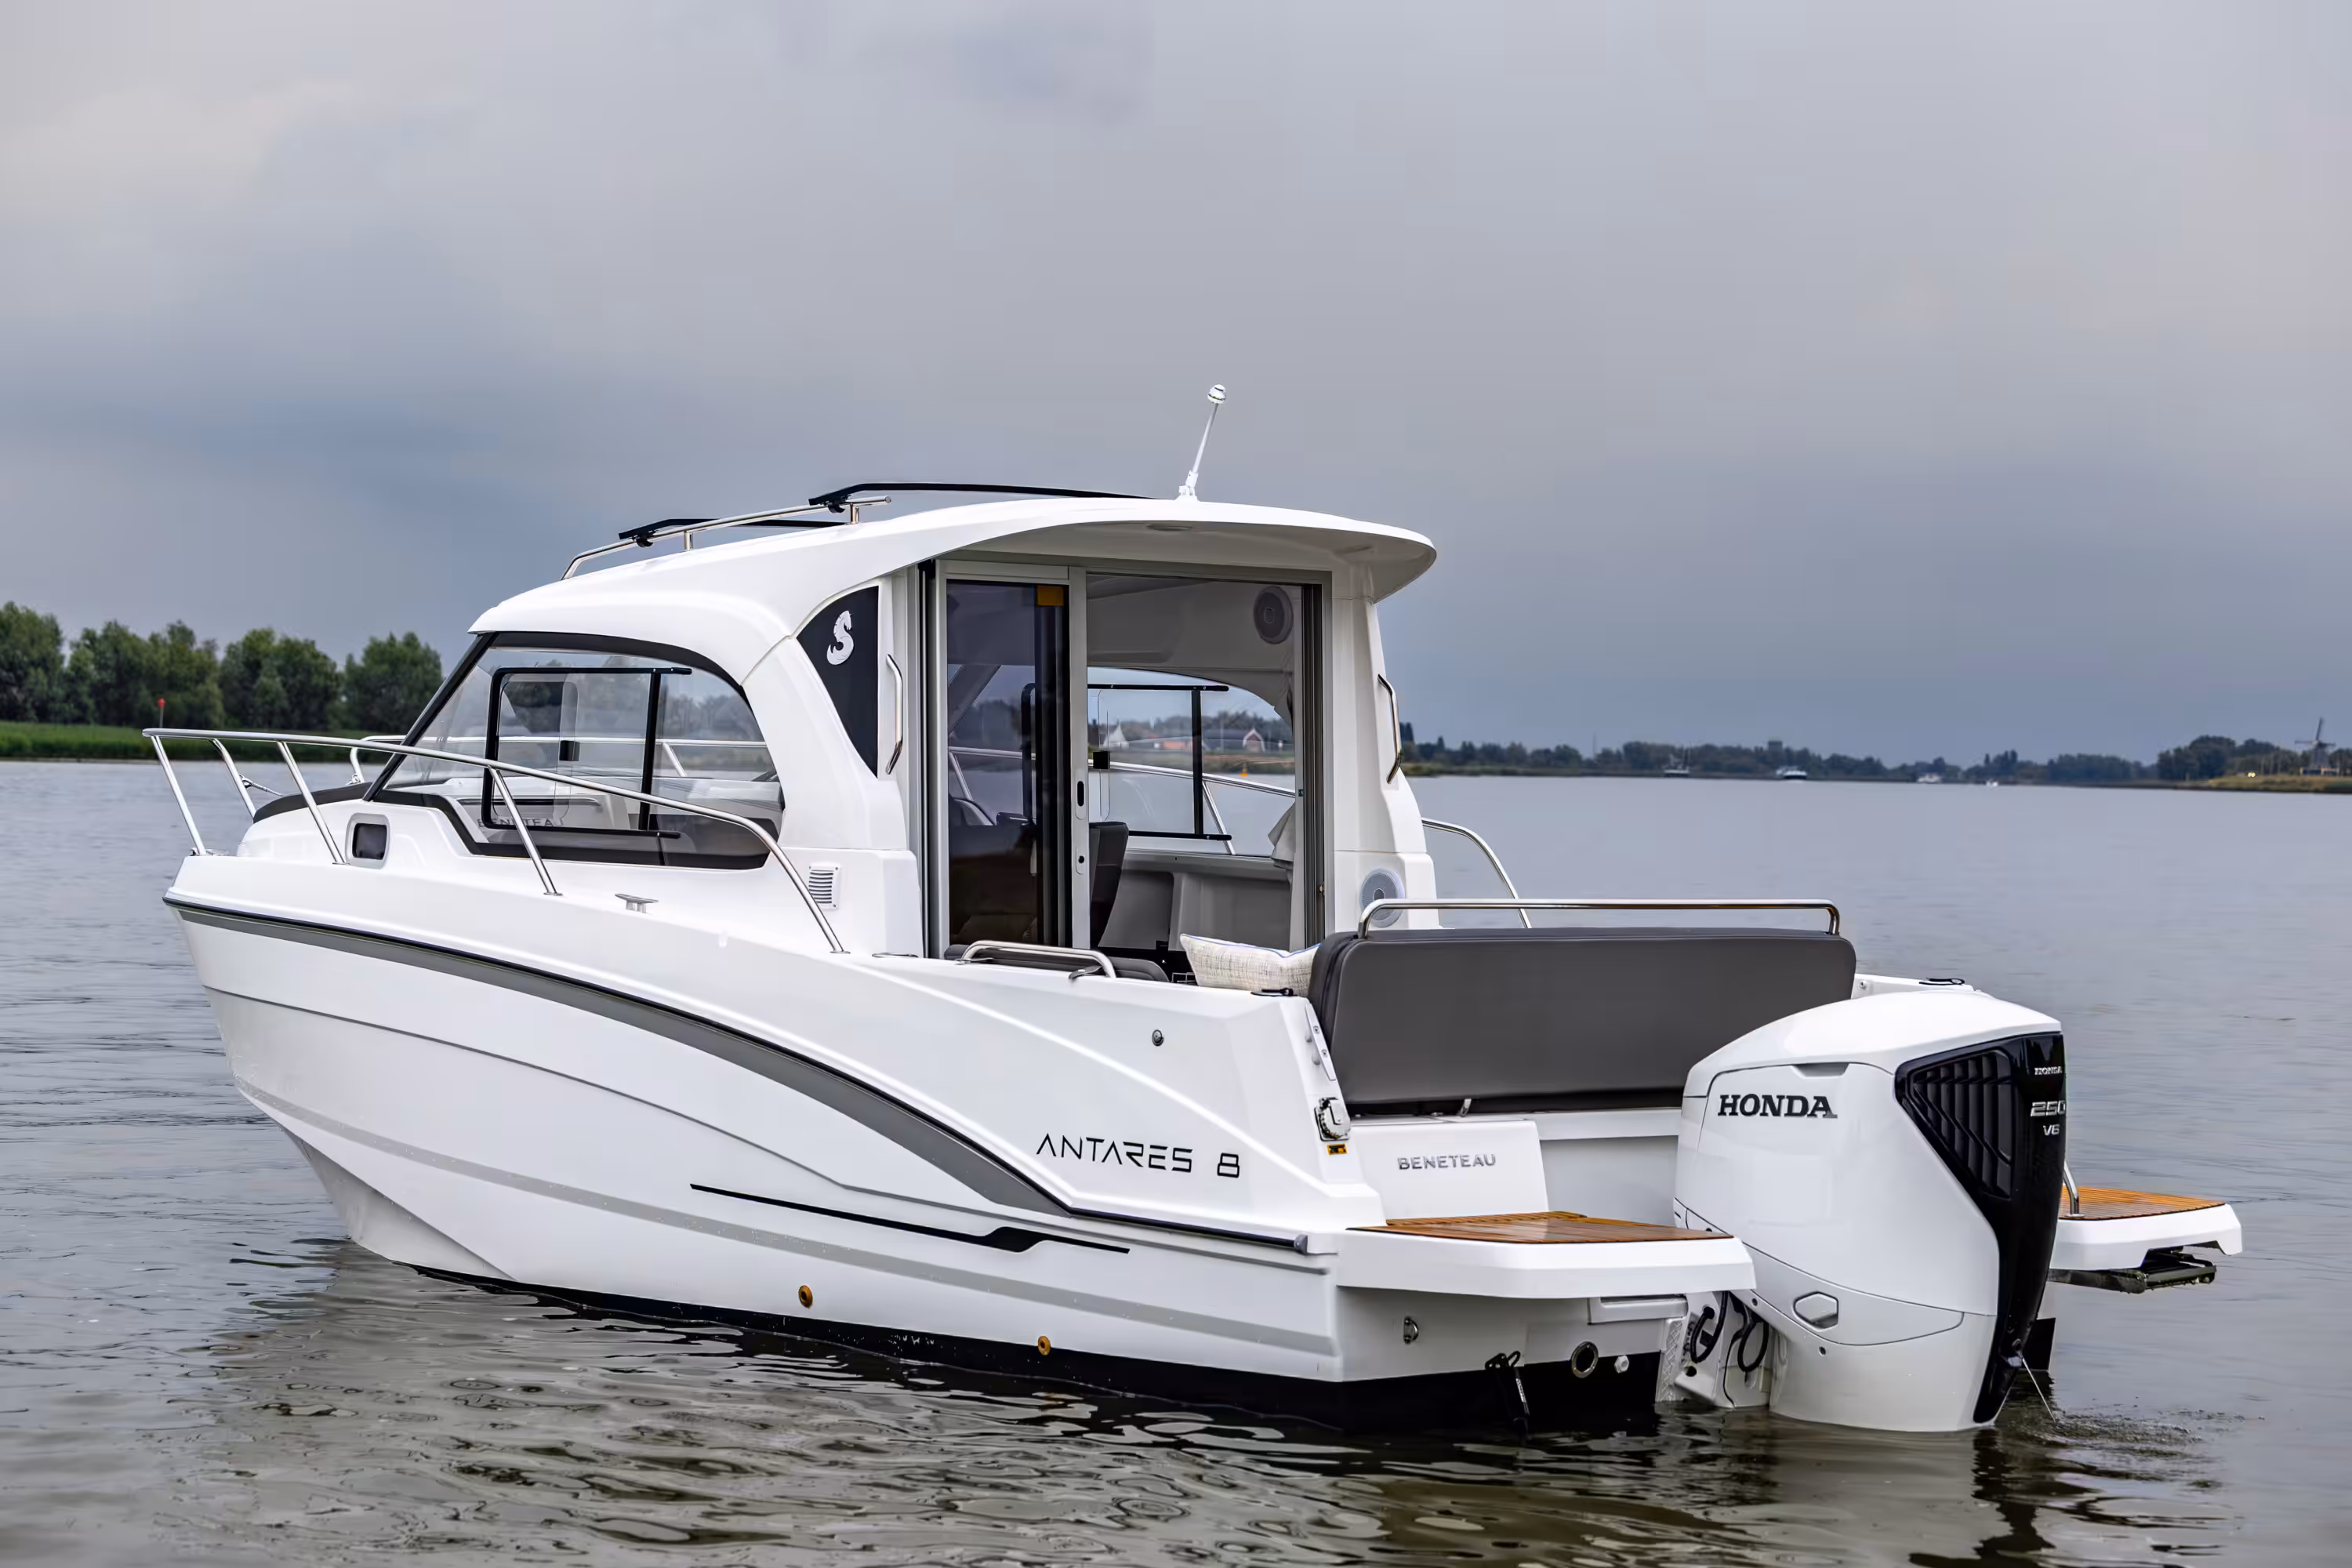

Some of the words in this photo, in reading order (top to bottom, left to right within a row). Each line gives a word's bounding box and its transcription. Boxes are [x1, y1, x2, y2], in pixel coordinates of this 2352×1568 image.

[2034, 1066, 2063, 1076] HONDA
[1718, 1093, 1838, 1119] HONDA
[2030, 1100, 2066, 1117] 250
[2042, 1123, 2060, 1136] V6
[1036, 1132, 1193, 1173] ANTARES
[1217, 1152, 1240, 1178] 8
[1397, 1153, 1497, 1170] BENETEAU
